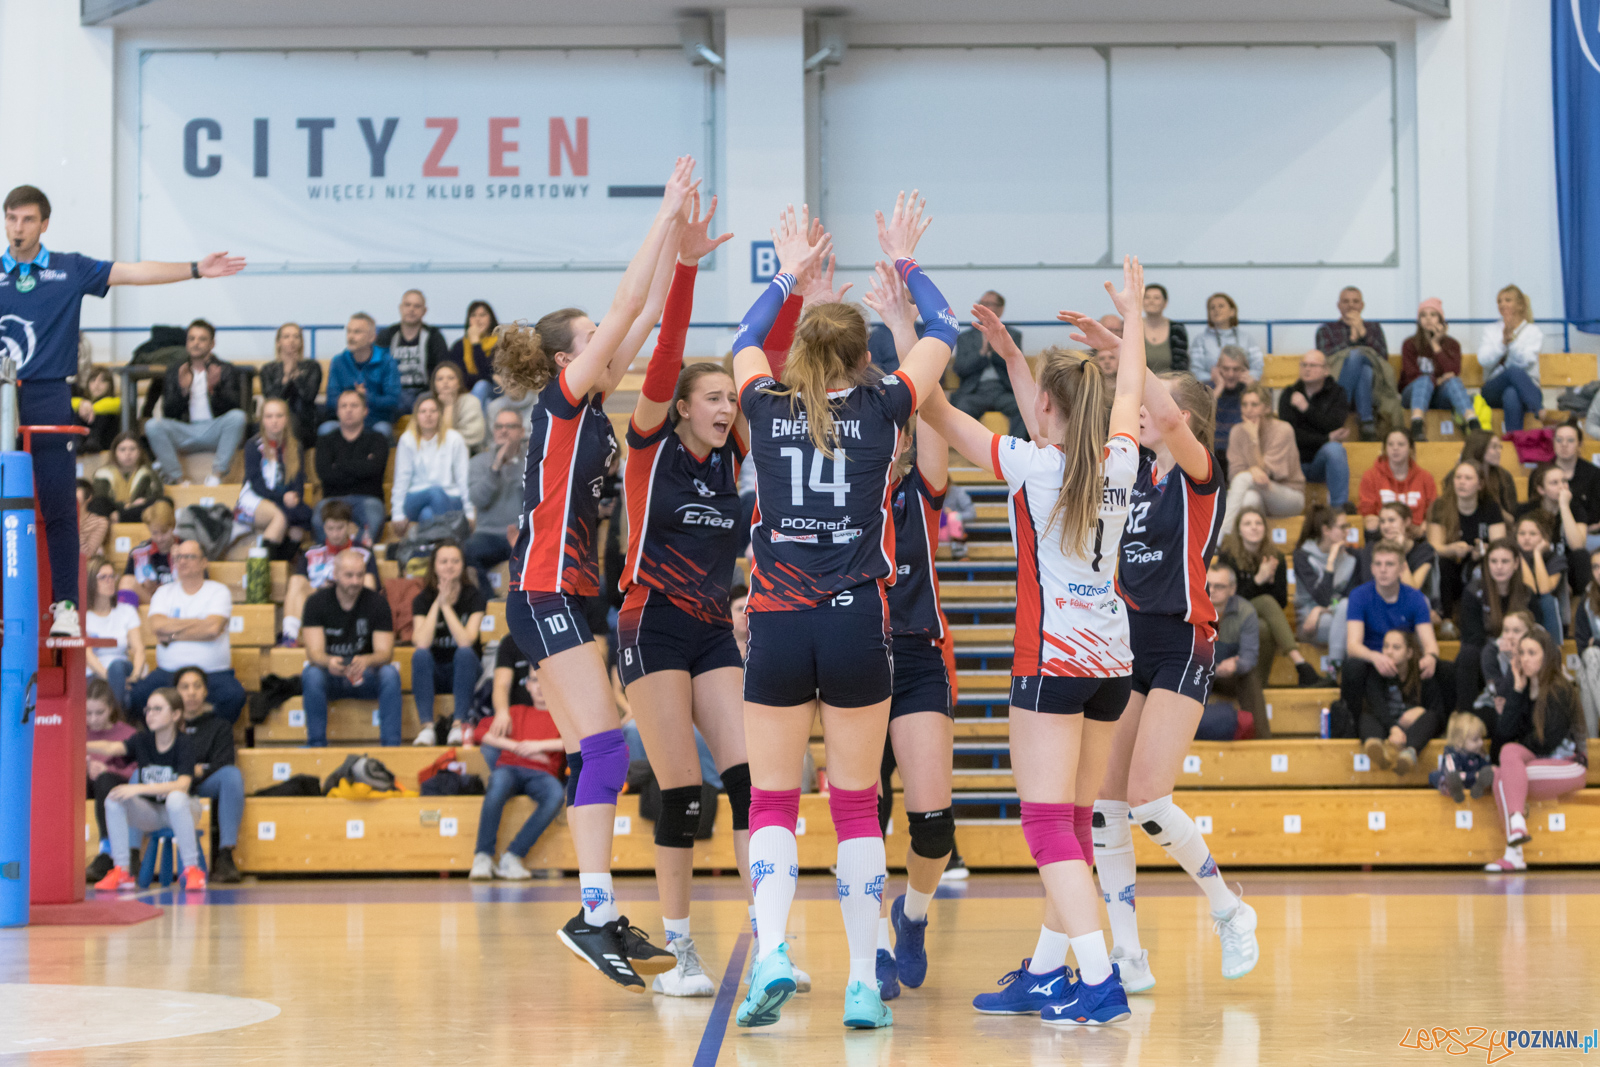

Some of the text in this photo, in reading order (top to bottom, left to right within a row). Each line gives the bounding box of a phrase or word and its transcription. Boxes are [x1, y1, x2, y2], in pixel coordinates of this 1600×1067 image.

[183, 117, 589, 178] CITYZEN
[307, 184, 375, 201] WIĘCEJ
[427, 184, 475, 199] KLUB
[486, 184, 589, 199] SPORTOWY
[756, 247, 776, 277] B
[780, 447, 851, 507] 14
[682, 510, 736, 530] Enea
[1126, 501, 1152, 534] 12
[544, 613, 569, 635] 10
[624, 647, 634, 666] 8
[35, 713, 62, 726] noh
